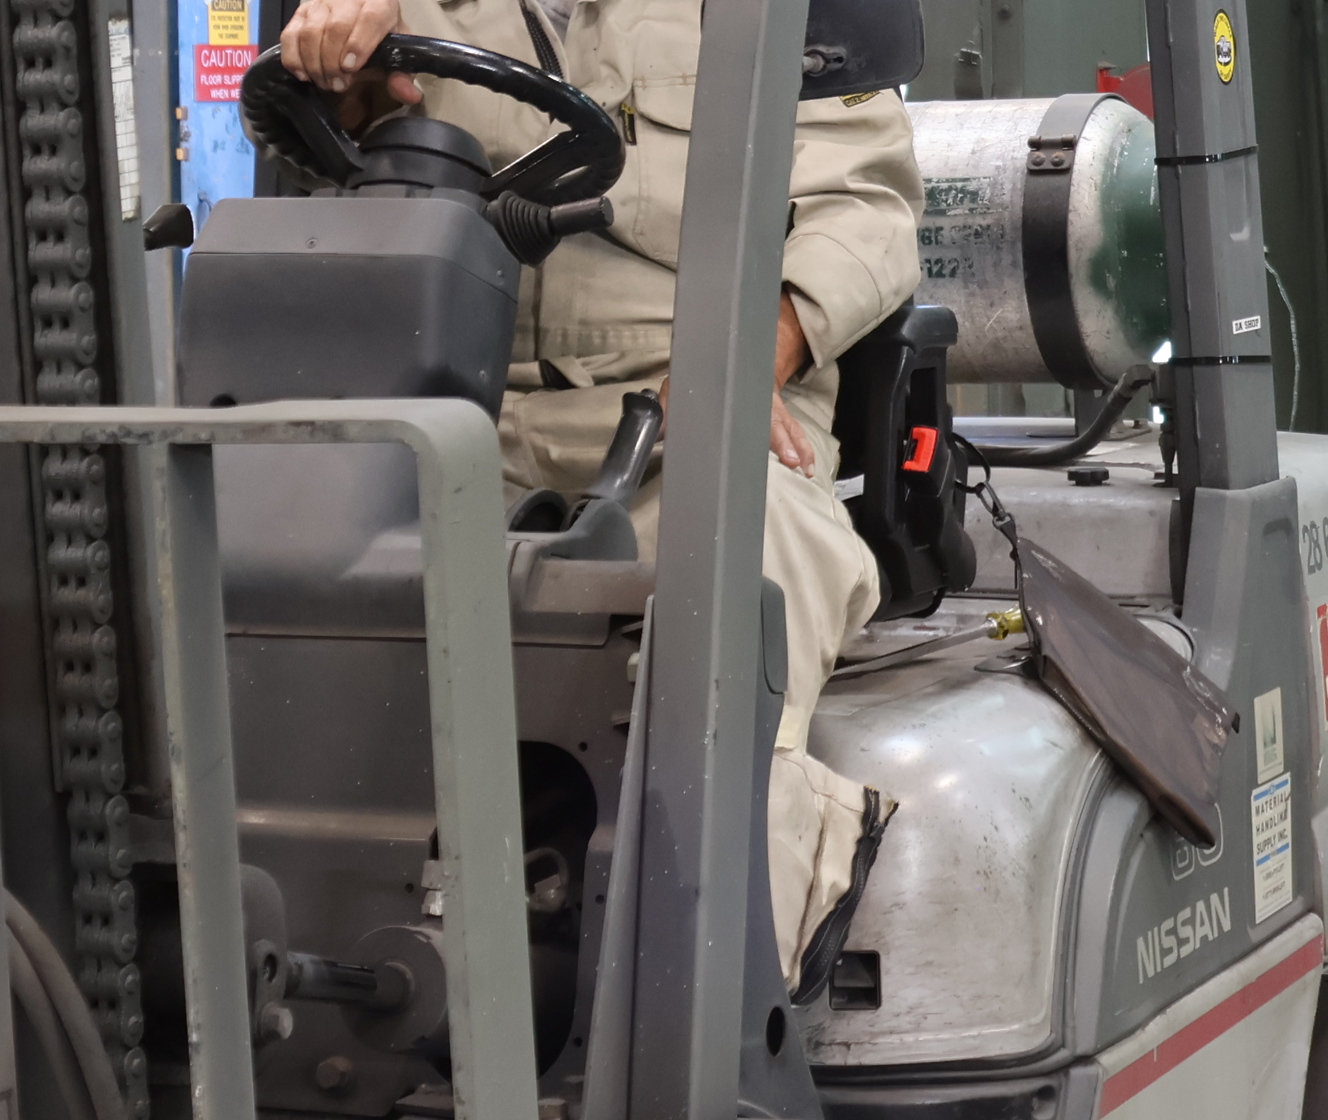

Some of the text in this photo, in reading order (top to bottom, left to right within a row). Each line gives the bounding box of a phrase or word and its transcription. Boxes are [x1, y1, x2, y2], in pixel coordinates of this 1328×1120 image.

[214, 0, 242, 10] CAUTION
[201, 50, 252, 67] CAUTION
[200, 75, 244, 85] FLOOR SLIPPE
[210, 89, 242, 98] WHEN WE
[1244, 318, 1259, 330] SHOP
[1255, 791, 1288, 817] MATERIAL
[1256, 837, 1278, 856] SUPPLY
[1136, 887, 1231, 985] NISSAN
